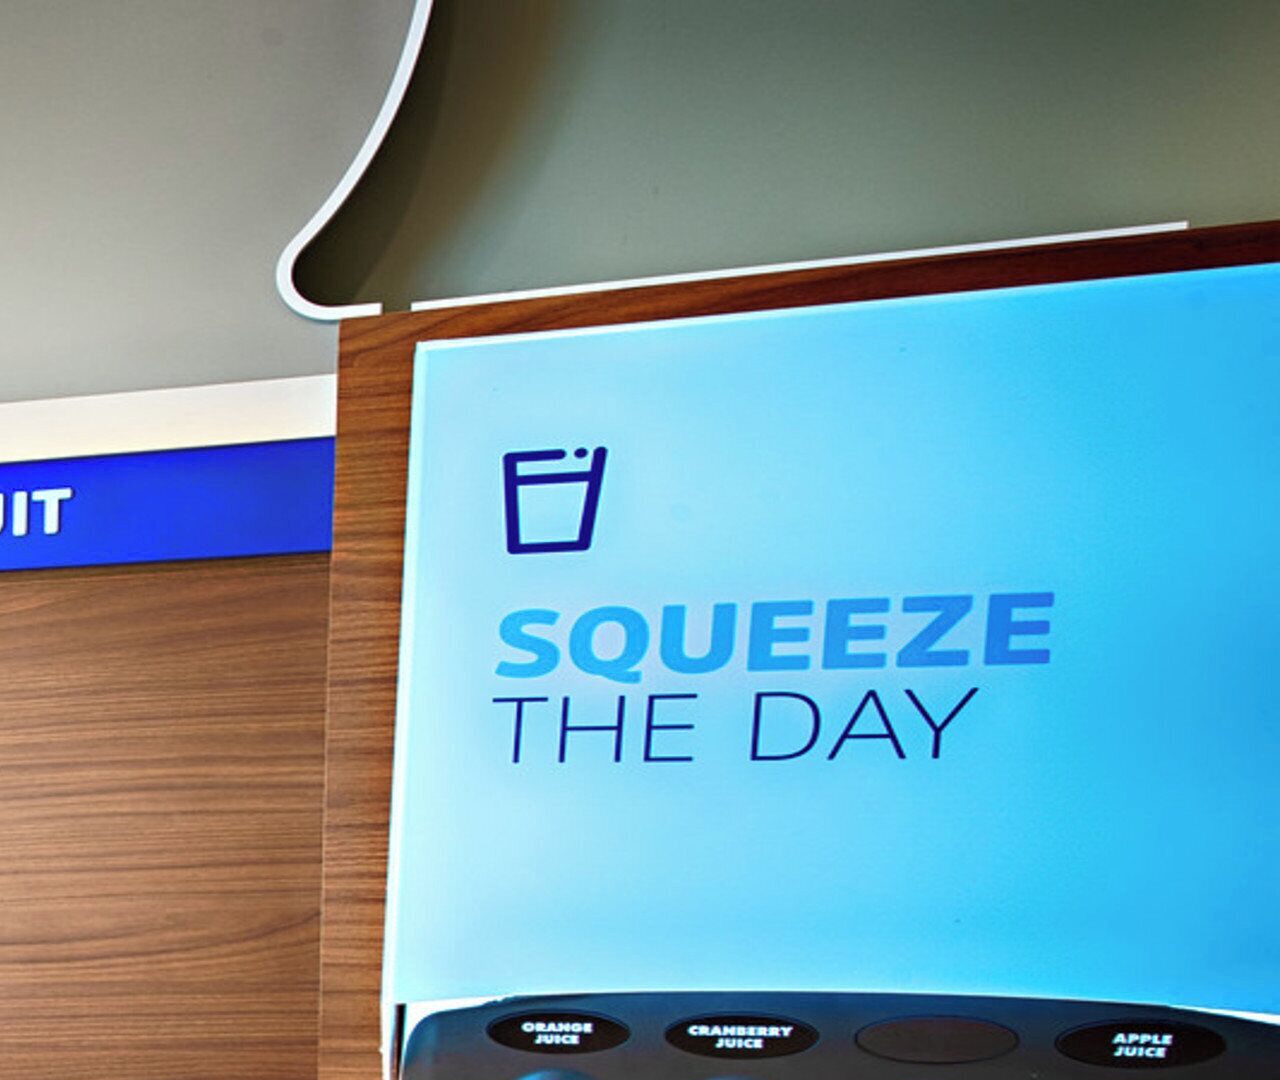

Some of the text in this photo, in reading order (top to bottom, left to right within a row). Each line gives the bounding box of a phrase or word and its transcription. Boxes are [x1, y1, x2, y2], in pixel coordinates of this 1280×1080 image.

[494, 591, 1056, 685] SQUEEZE
[492, 687, 980, 764] THE DAY
[521, 1022, 593, 1034] ORANGE
[687, 1024, 793, 1038] CRANBERRY
[534, 1034, 580, 1046] JUICE
[715, 1038, 763, 1050] JUICE
[1111, 1032, 1173, 1046] APPLE
[1113, 1046, 1166, 1059] JUICE
